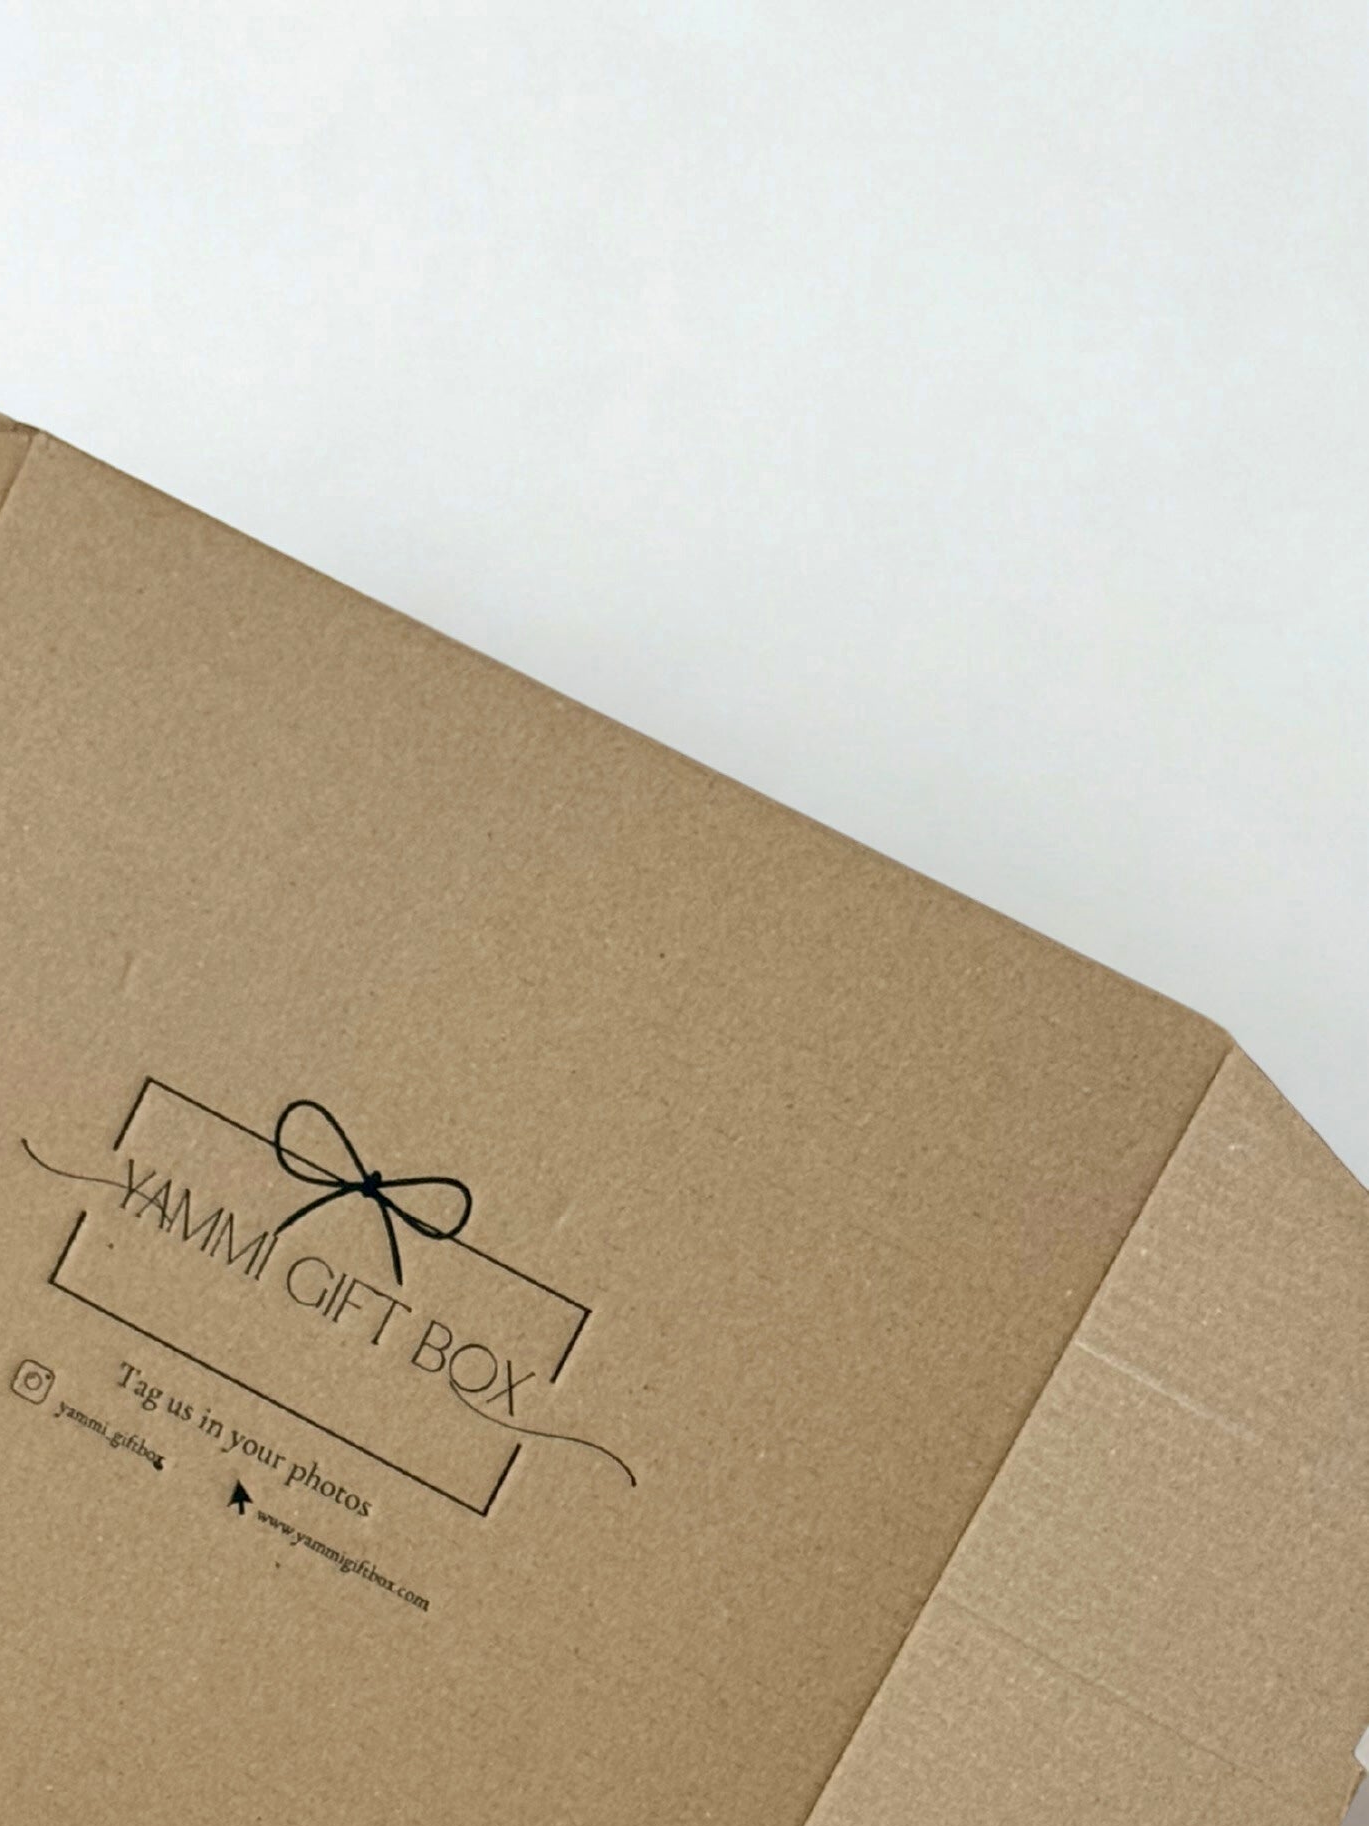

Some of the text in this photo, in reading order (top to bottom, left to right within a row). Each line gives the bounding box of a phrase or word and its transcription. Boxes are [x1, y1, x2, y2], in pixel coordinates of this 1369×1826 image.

[119, 1158, 536, 1417] YAMMI GIFT BOX
[118, 1361, 373, 1518] Tag us in your photos
[257, 1510, 431, 1613] www.yammigiftbox.com
